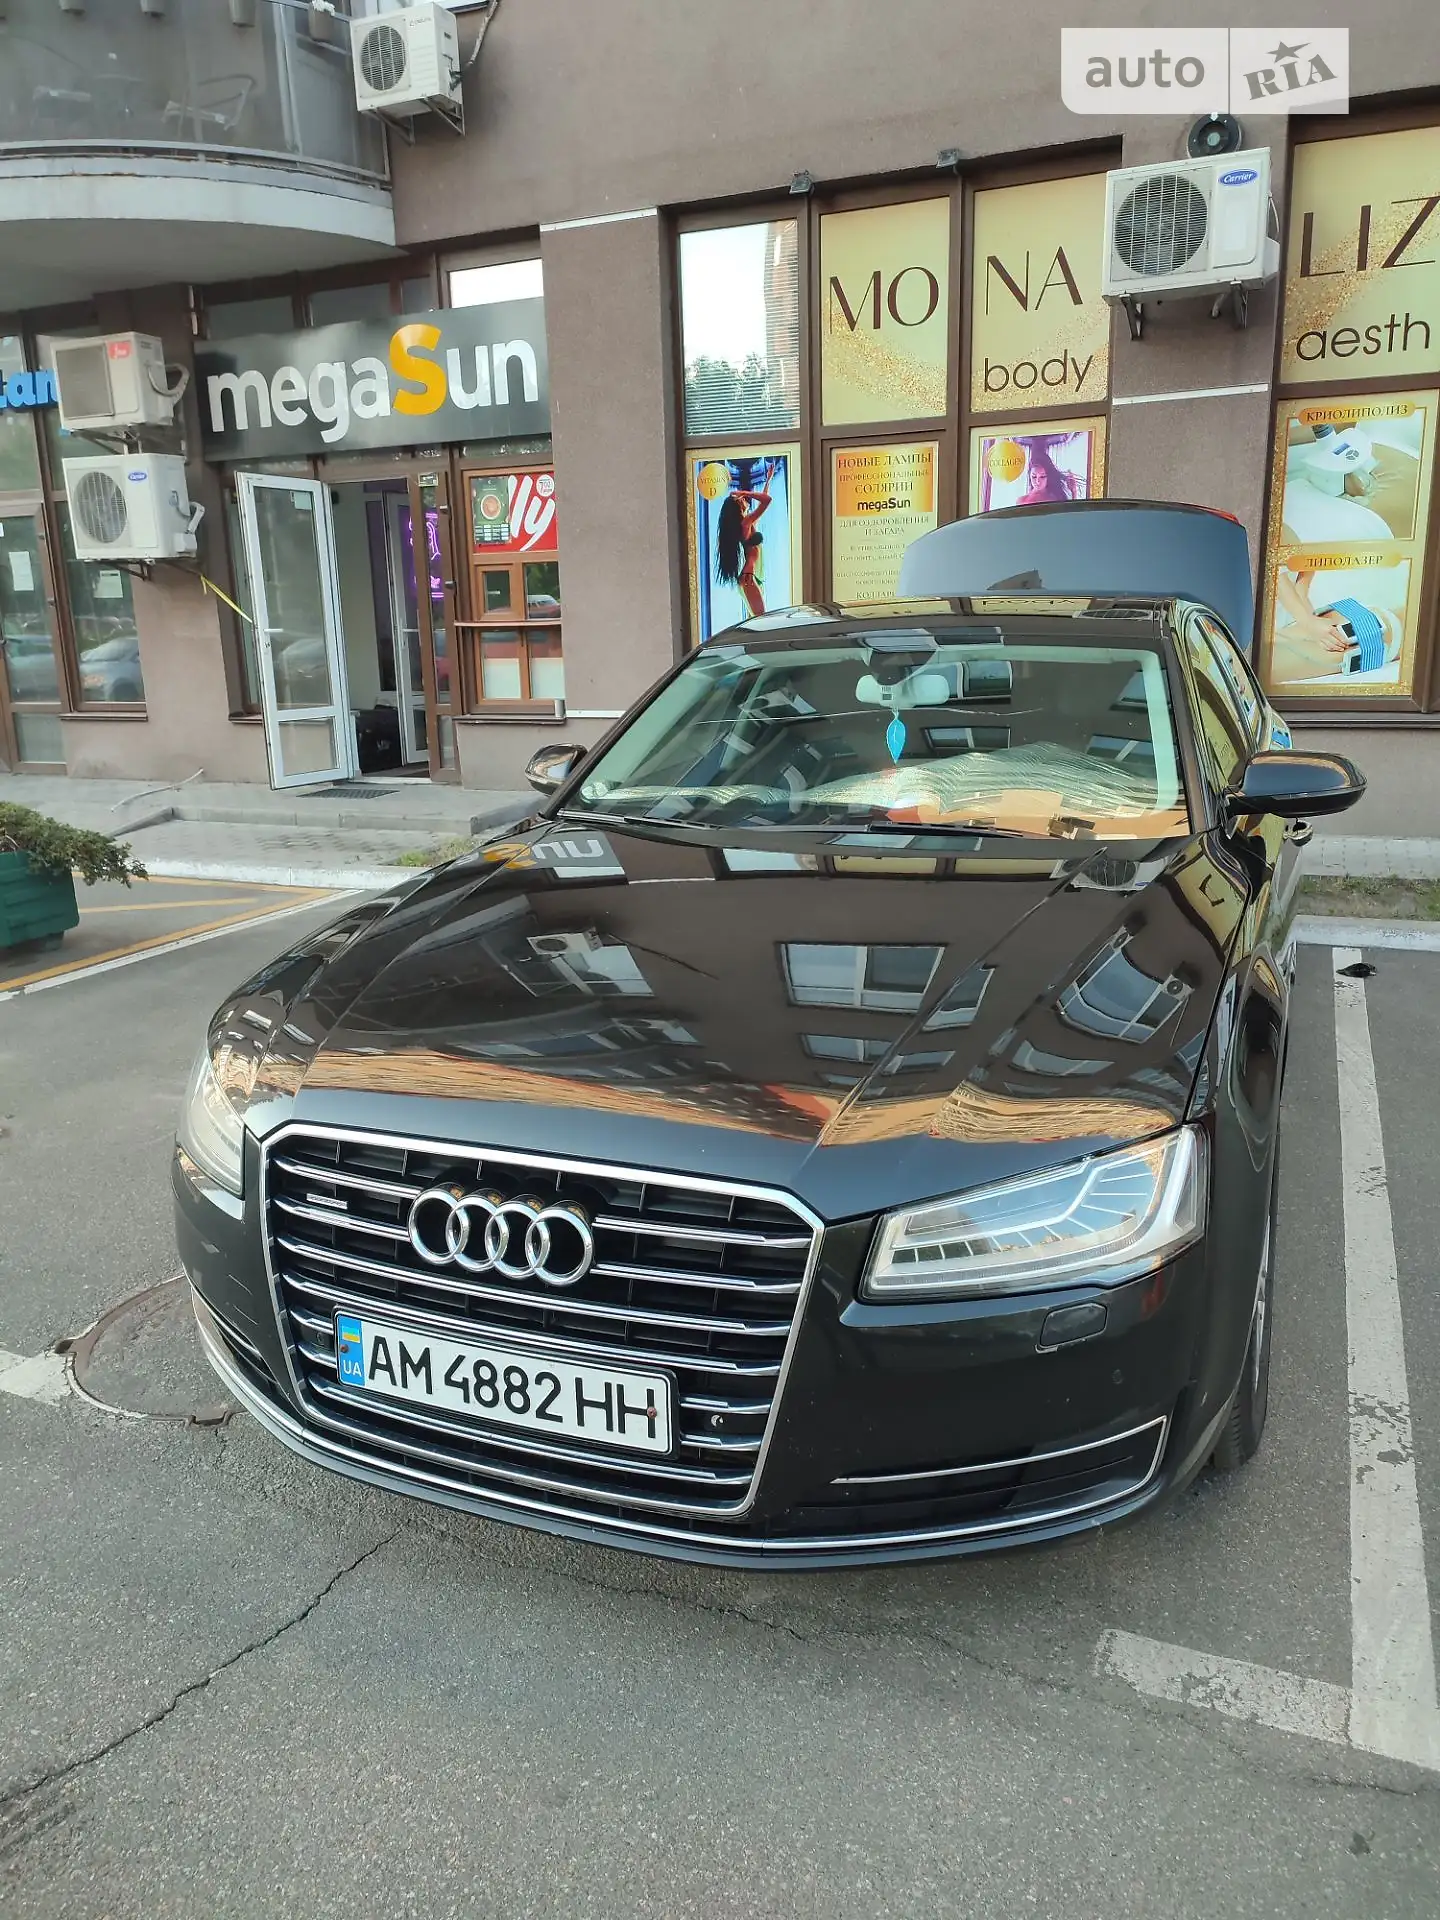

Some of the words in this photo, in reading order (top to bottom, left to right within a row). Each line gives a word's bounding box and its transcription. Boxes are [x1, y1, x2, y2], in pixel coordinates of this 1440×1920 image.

[1223, 172, 1255, 184] Carrier
[1296, 312, 1430, 361] aesth
[984, 349, 1093, 393] body
[207, 323, 538, 443] megaSun
[1306, 404, 1408, 421] КРИОЛИПОЛИЗ
[838, 456, 881, 469] НОВЫЕ
[883, 452, 932, 466] ЛАМПЫ
[989, 456, 1024, 467] COLLAGEN
[700, 476, 726, 485] VITAMIN
[855, 481, 914, 494] СОЛЯРИИ
[709, 488, 717, 497] D
[857, 497, 911, 512] megaSun
[1305, 556, 1383, 568] ЛИПОЛАЗЕР
[343, 1359, 363, 1377] UA
[368, 1335, 433, 1395] AM
[444, 1354, 564, 1424] 4882
[575, 1377, 656, 1439] HH
